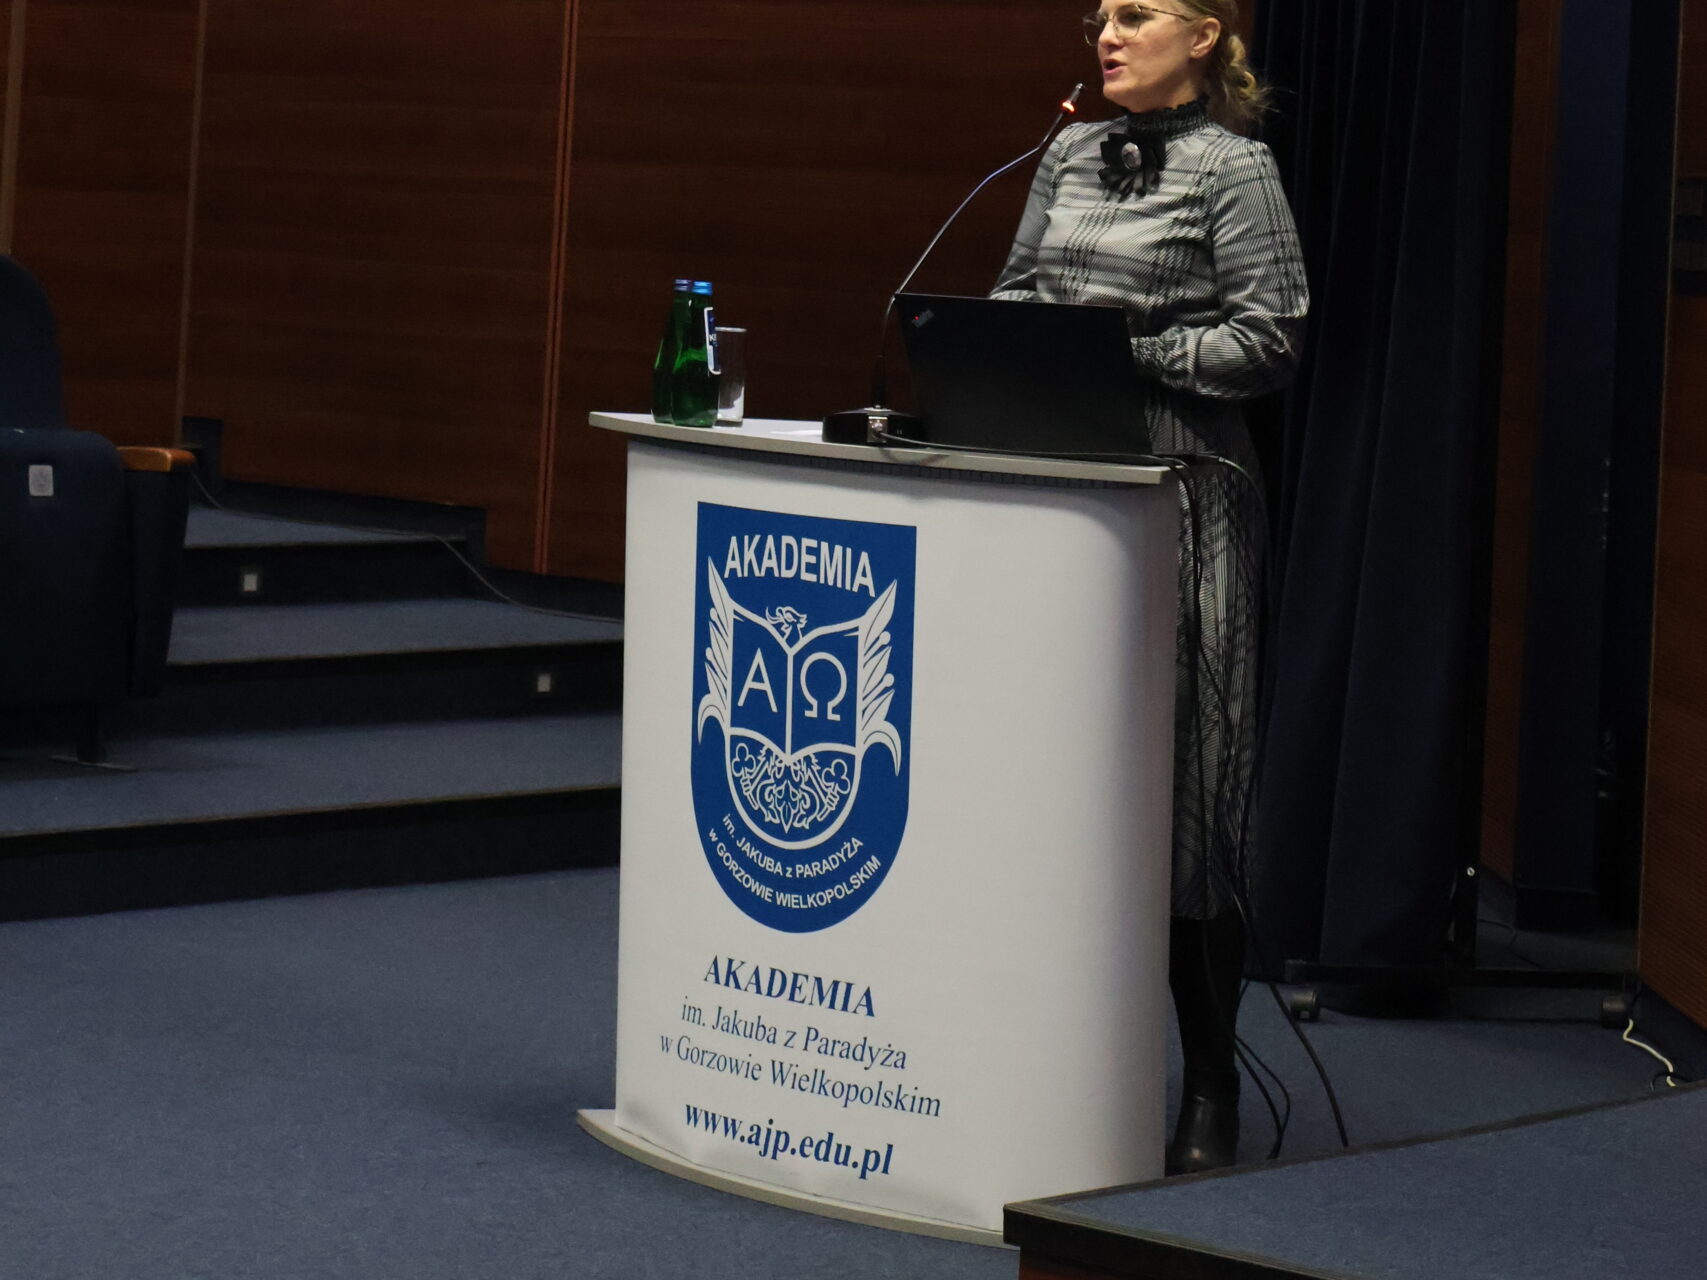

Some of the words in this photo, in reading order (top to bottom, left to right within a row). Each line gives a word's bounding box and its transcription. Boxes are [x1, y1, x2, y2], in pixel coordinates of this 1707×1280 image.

[724, 534, 876, 597] AKADEMIA
[708, 828, 718, 843] w
[716, 845, 774, 902] GORZOWIE
[775, 854, 882, 909] WIELKOPOLSKIM
[723, 813, 735, 840] im.
[736, 836, 783, 874] JAKUBA
[786, 867, 793, 877] z
[796, 836, 864, 878] PARADYŻA
[704, 955, 875, 1018] AKADEMIA
[681, 996, 706, 1027] im.
[711, 1006, 777, 1045] Jakuba
[783, 1030, 797, 1049] z
[803, 1027, 907, 1070] Paradyża
[660, 1035, 673, 1053] w
[677, 1035, 762, 1081] Gorzowie
[770, 1060, 941, 1117] Wielkopolskim
[685, 1104, 894, 1180] www.ajp.edu.pl
